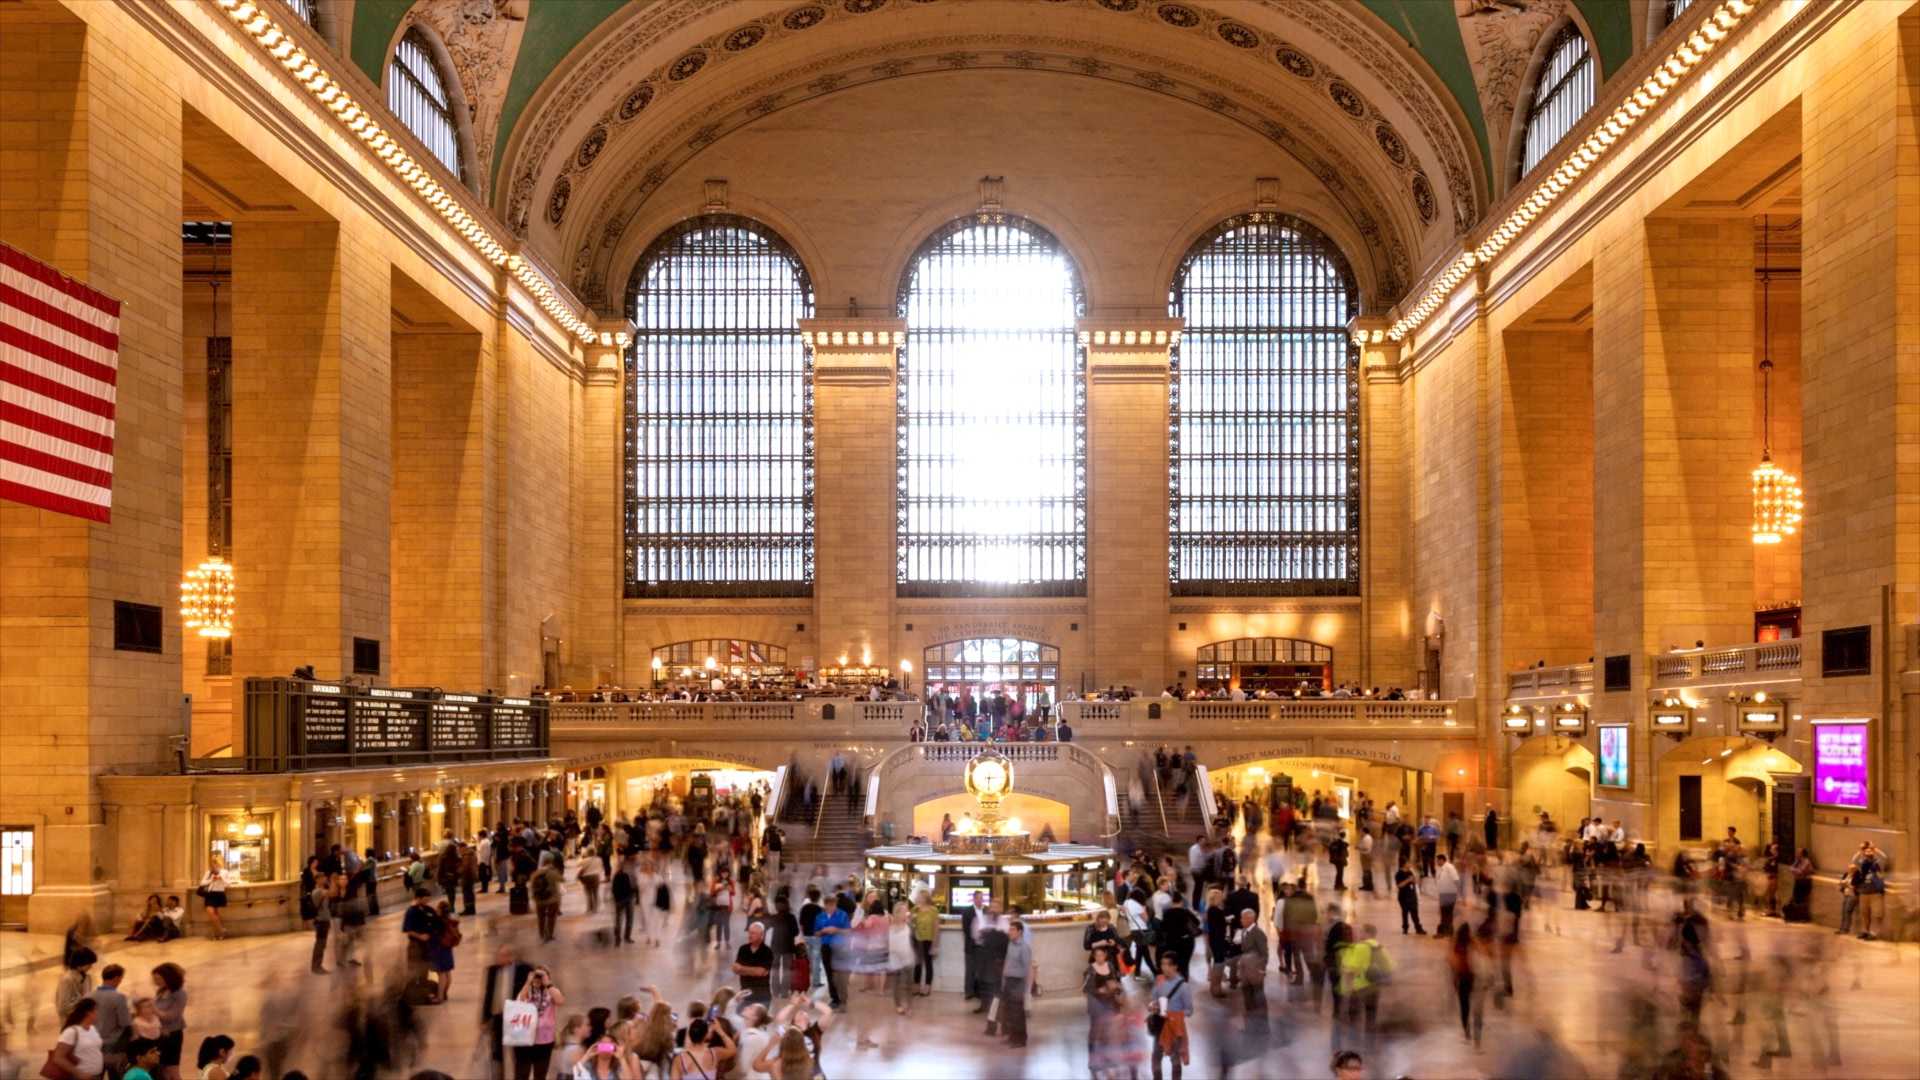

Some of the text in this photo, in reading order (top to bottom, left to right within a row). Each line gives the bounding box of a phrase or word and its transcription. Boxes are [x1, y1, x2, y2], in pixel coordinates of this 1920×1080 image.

[568, 748, 652, 766] TICKET MACHINES
[1226, 747, 1304, 764] TICKET MACHINES
